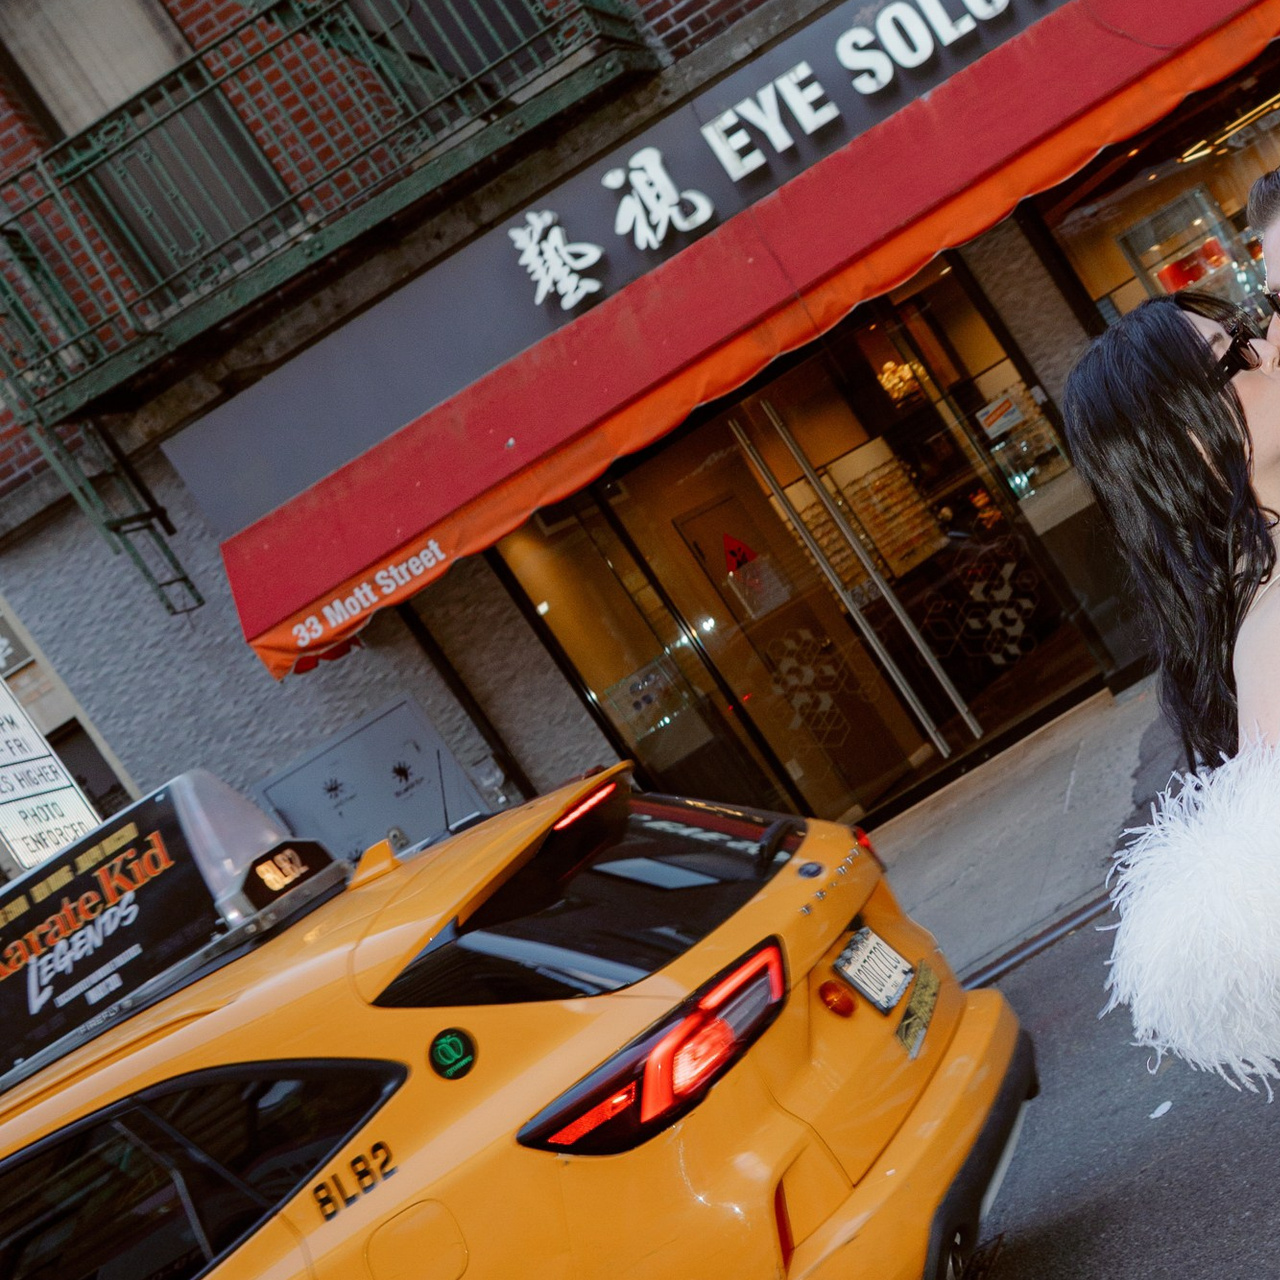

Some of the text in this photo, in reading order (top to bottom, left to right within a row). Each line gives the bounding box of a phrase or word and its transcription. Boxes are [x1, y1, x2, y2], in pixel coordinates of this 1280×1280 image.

[701, 61, 840, 182] EYE
[291, 538, 447, 648] 33 Mott Street
[14, 764, 61, 790] HIGHER
[17, 801, 65, 823] PHOTO
[92, 829, 176, 908] Kid
[26, 890, 140, 1016] LEGENDS
[853, 941, 901, 997] Y207272C
[311, 1140, 399, 1222] 8L82
